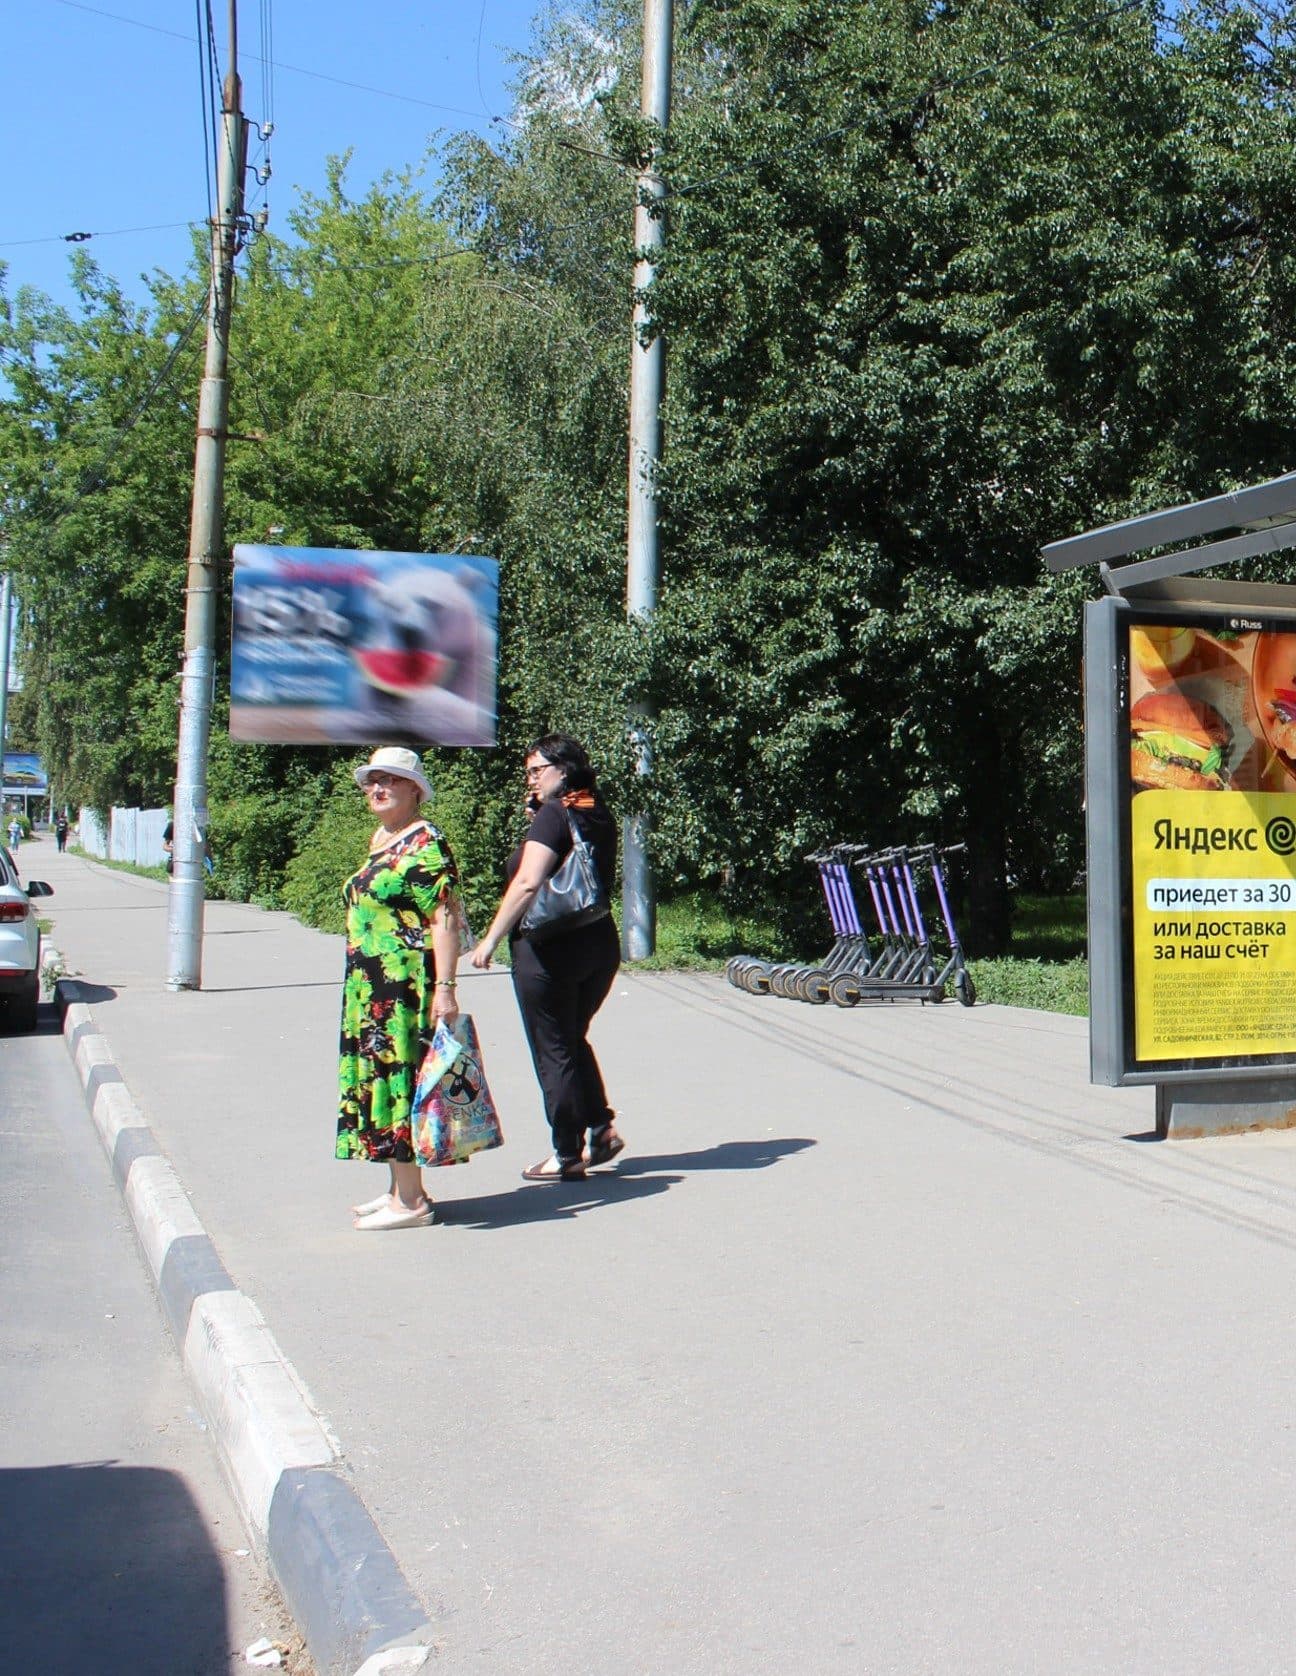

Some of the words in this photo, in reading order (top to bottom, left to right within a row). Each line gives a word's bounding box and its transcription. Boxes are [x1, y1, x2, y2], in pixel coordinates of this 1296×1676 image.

[1240, 619, 1262, 629] Russ
[1153, 819, 1258, 855] Яндекс
[1153, 887, 1239, 906] приедет
[1243, 888, 1264, 903] за
[1268, 884, 1291, 903] 30
[1153, 921, 1191, 936] или
[1195, 920, 1286, 939] доставка
[1153, 944, 1175, 960] за
[1180, 944, 1220, 959] наш
[1225, 939, 1269, 958] счёт
